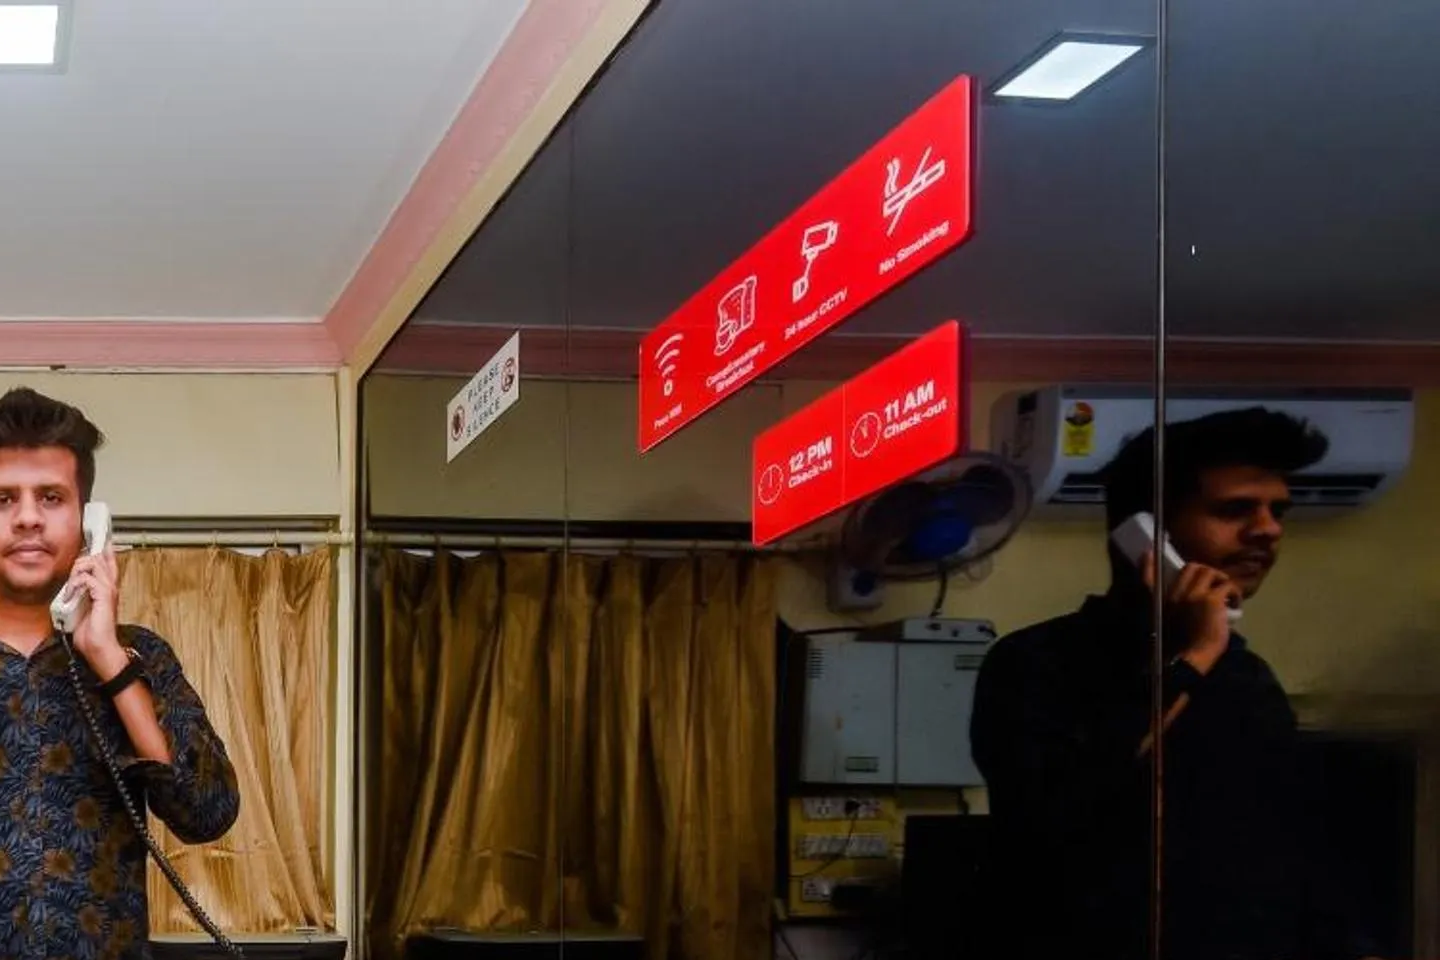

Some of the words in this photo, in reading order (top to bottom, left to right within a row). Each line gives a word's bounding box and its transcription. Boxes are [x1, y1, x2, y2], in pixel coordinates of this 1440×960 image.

[883, 397, 948, 439] Check-out
[884, 397, 899, 421] 11
[903, 380, 934, 415] AM
[788, 452, 804, 472] 12
[807, 436, 833, 463] PM
